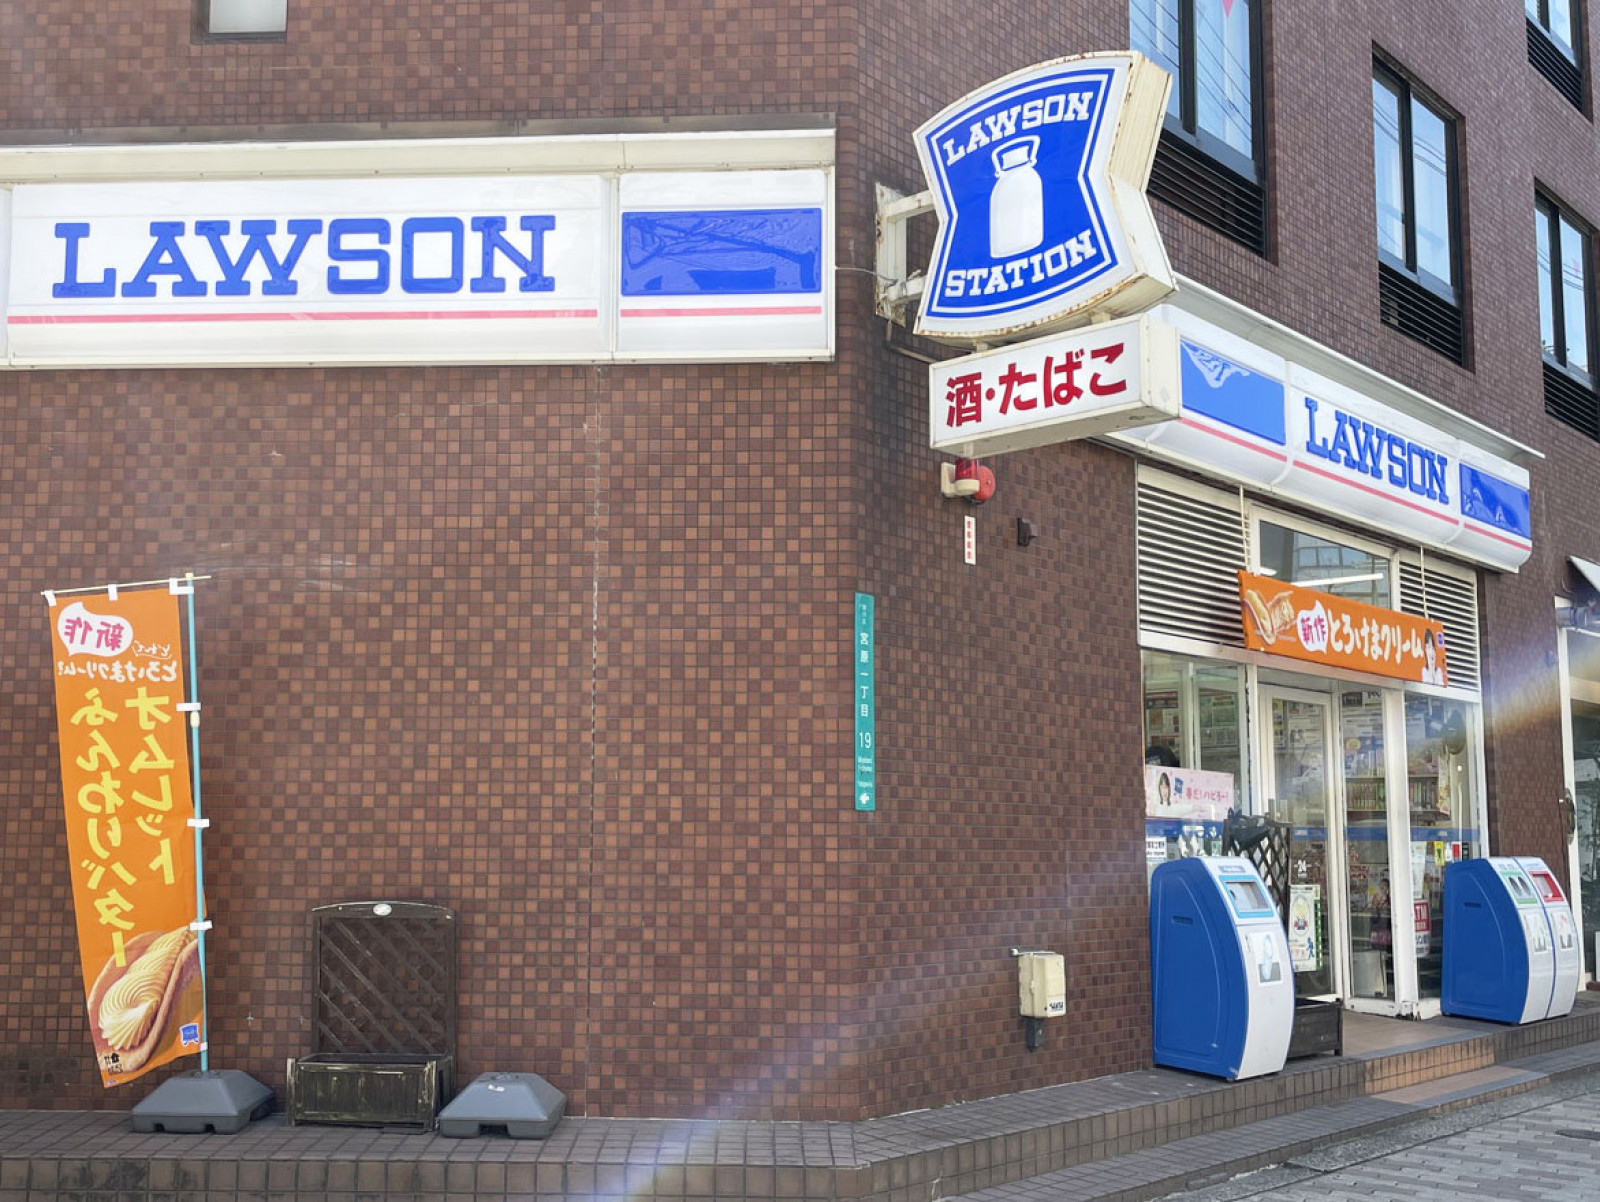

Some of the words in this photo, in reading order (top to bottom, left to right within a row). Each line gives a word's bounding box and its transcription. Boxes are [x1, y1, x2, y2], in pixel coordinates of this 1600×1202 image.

[943, 91, 1094, 167] LAWSON
[52, 215, 556, 298] LAWSON
[944, 229, 1096, 298] STATION
[1304, 397, 1449, 505] LAWSON
[1301, 616, 1326, 643] 新作
[859, 732, 871, 749] 19
